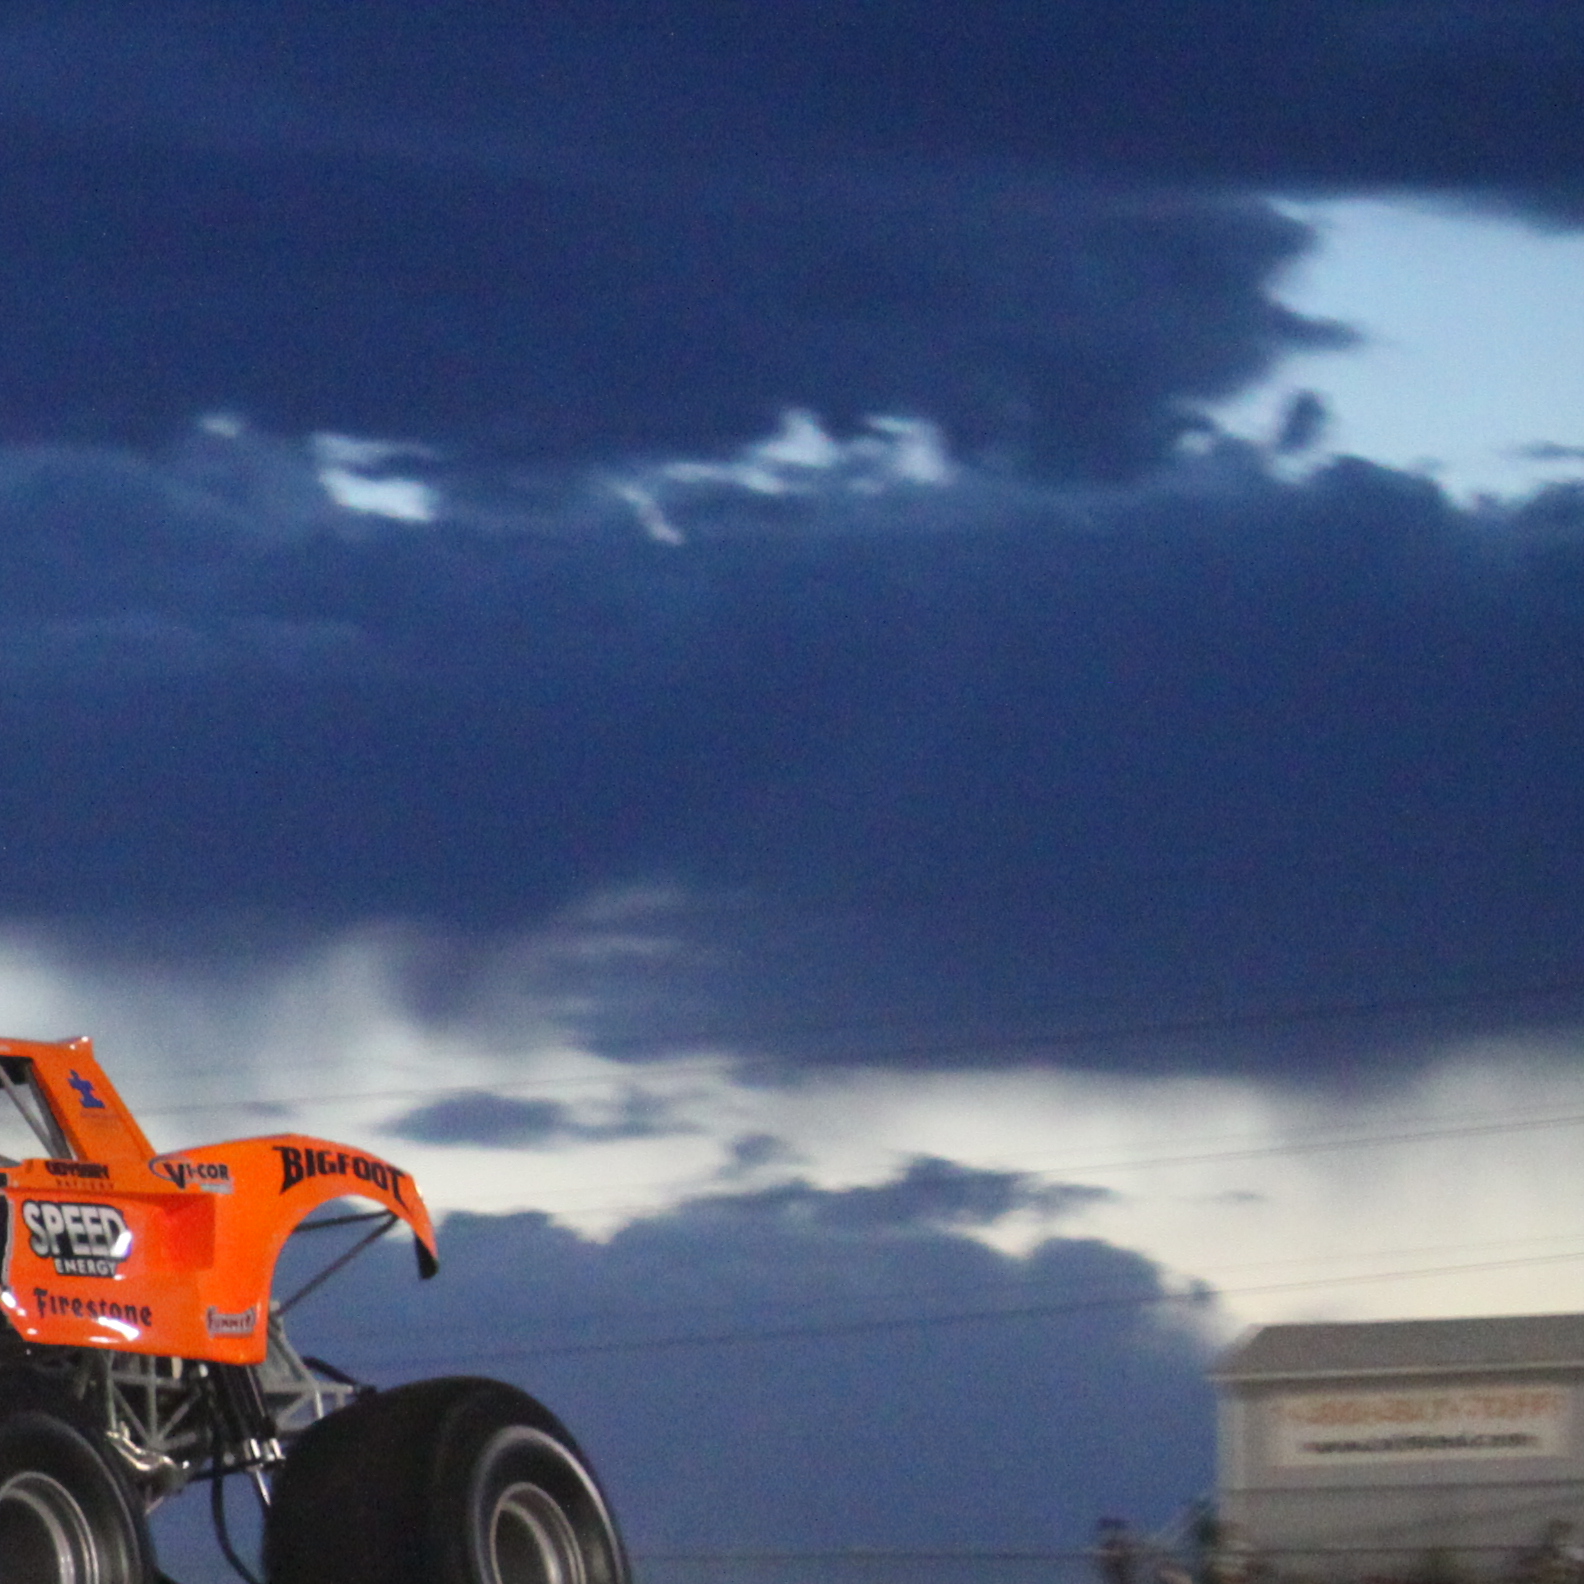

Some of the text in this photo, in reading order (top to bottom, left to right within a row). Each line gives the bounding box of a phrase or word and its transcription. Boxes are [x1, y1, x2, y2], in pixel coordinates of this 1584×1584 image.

[272, 1146, 410, 1212] BIGFOOT
[22, 1199, 132, 1258] SPEED
[54, 1258, 117, 1276] ENERGY
[34, 1288, 152, 1327] Firestone
